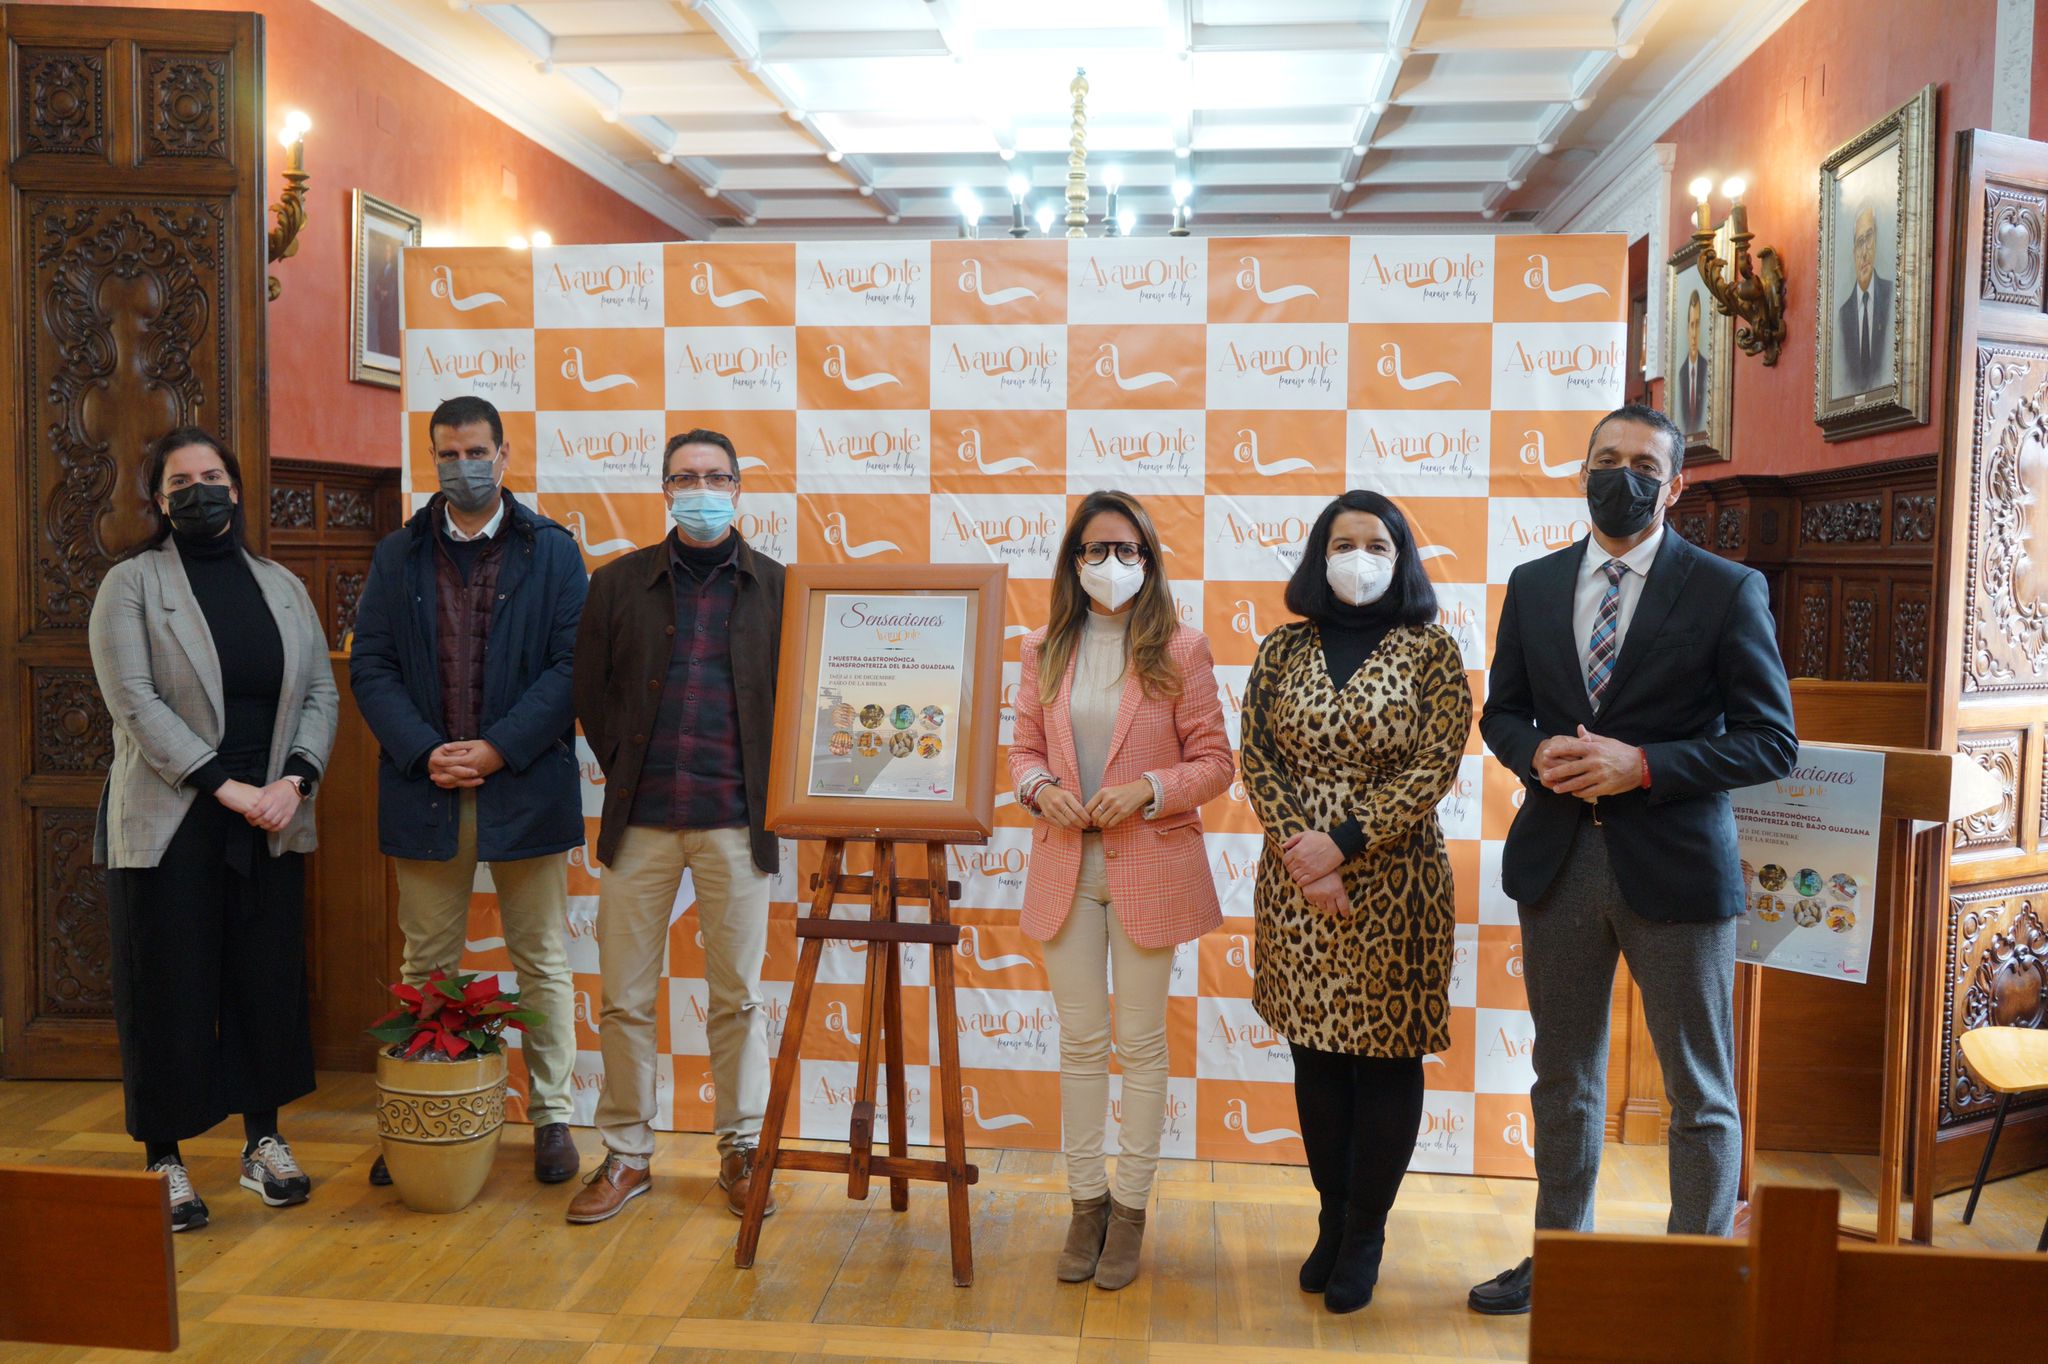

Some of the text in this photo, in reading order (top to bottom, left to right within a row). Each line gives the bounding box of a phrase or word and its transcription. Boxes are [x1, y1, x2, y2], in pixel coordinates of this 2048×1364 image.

[626, 286, 636, 305] de
[892, 283, 901, 302] de
[1167, 280, 1177, 300] de
[1452, 278, 1462, 299] de
[498, 370, 508, 389] de
[758, 368, 768, 387] de
[1028, 367, 1037, 386] de
[1307, 366, 1317, 386] de
[1596, 366, 1607, 386] de
[628, 451, 637, 470] de
[892, 452, 901, 471] de
[1165, 452, 1175, 472] de
[1448, 453, 1458, 473] de
[1027, 536, 1036, 555] de
[840, 602, 944, 628] Sensaciones
[1733, 806, 1822, 823] UESTRA GASTRONÓMICA
[1791, 821, 1804, 829] DEL
[1806, 823, 1826, 831] BAJO
[1828, 826, 1870, 836] GUADIANA
[1024, 1031, 1033, 1047] de
